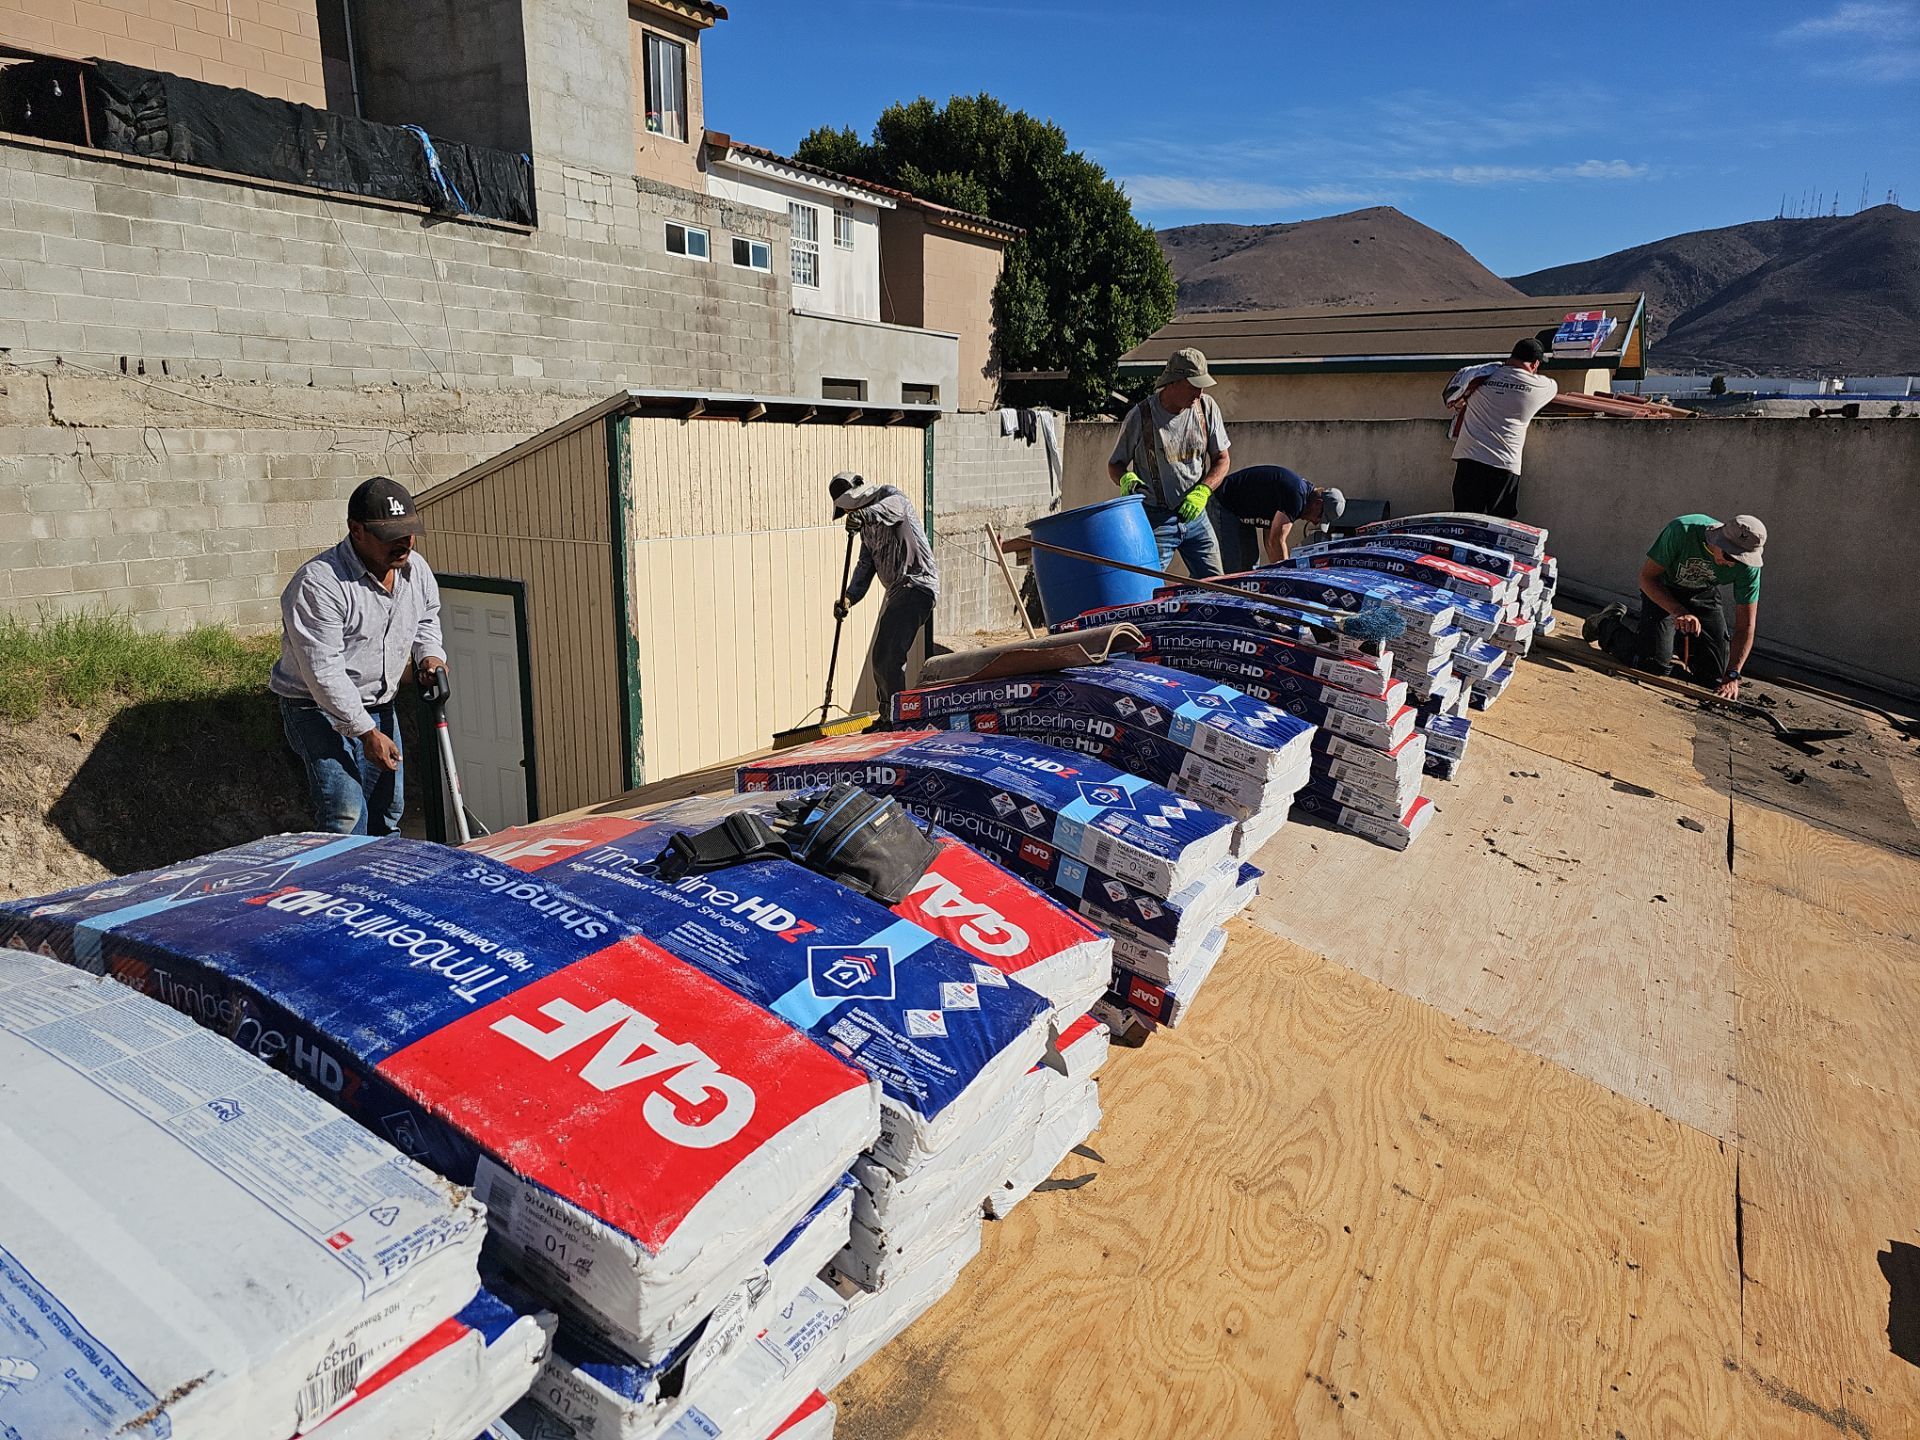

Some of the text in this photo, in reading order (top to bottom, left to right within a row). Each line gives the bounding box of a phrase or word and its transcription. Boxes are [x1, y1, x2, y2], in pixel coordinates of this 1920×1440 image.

[387, 496, 405, 515] LA
[902, 702, 919, 711] GAF
[978, 721, 996, 729] GAF
[1176, 720, 1191, 732] SF
[1234, 750, 1244, 758] 01
[747, 781, 768, 791] GAF
[1060, 821, 1078, 837] SF
[1023, 844, 1049, 860] GAF
[1063, 865, 1081, 880] SF
[463, 867, 609, 940] Shingles
[594, 868, 647, 891] Definition
[697, 905, 750, 934] Shingles
[434, 919, 500, 955] Definition
[1121, 942, 1134, 953] 01
[502, 949, 535, 973] High
[839, 970, 854, 980] 4
[1132, 988, 1160, 1007] GAF
[853, 1006, 894, 1036] Installation
[897, 1040, 909, 1051] de
[489, 997, 756, 1149] GAF
[856, 1055, 879, 1070] MADE
[880, 1067, 890, 1077] IN
[890, 1071, 905, 1084] THE
[545, 1233, 567, 1260] 01
[100, 1364, 115, 1380] DE
[693, 1417, 704, 1428] DE
